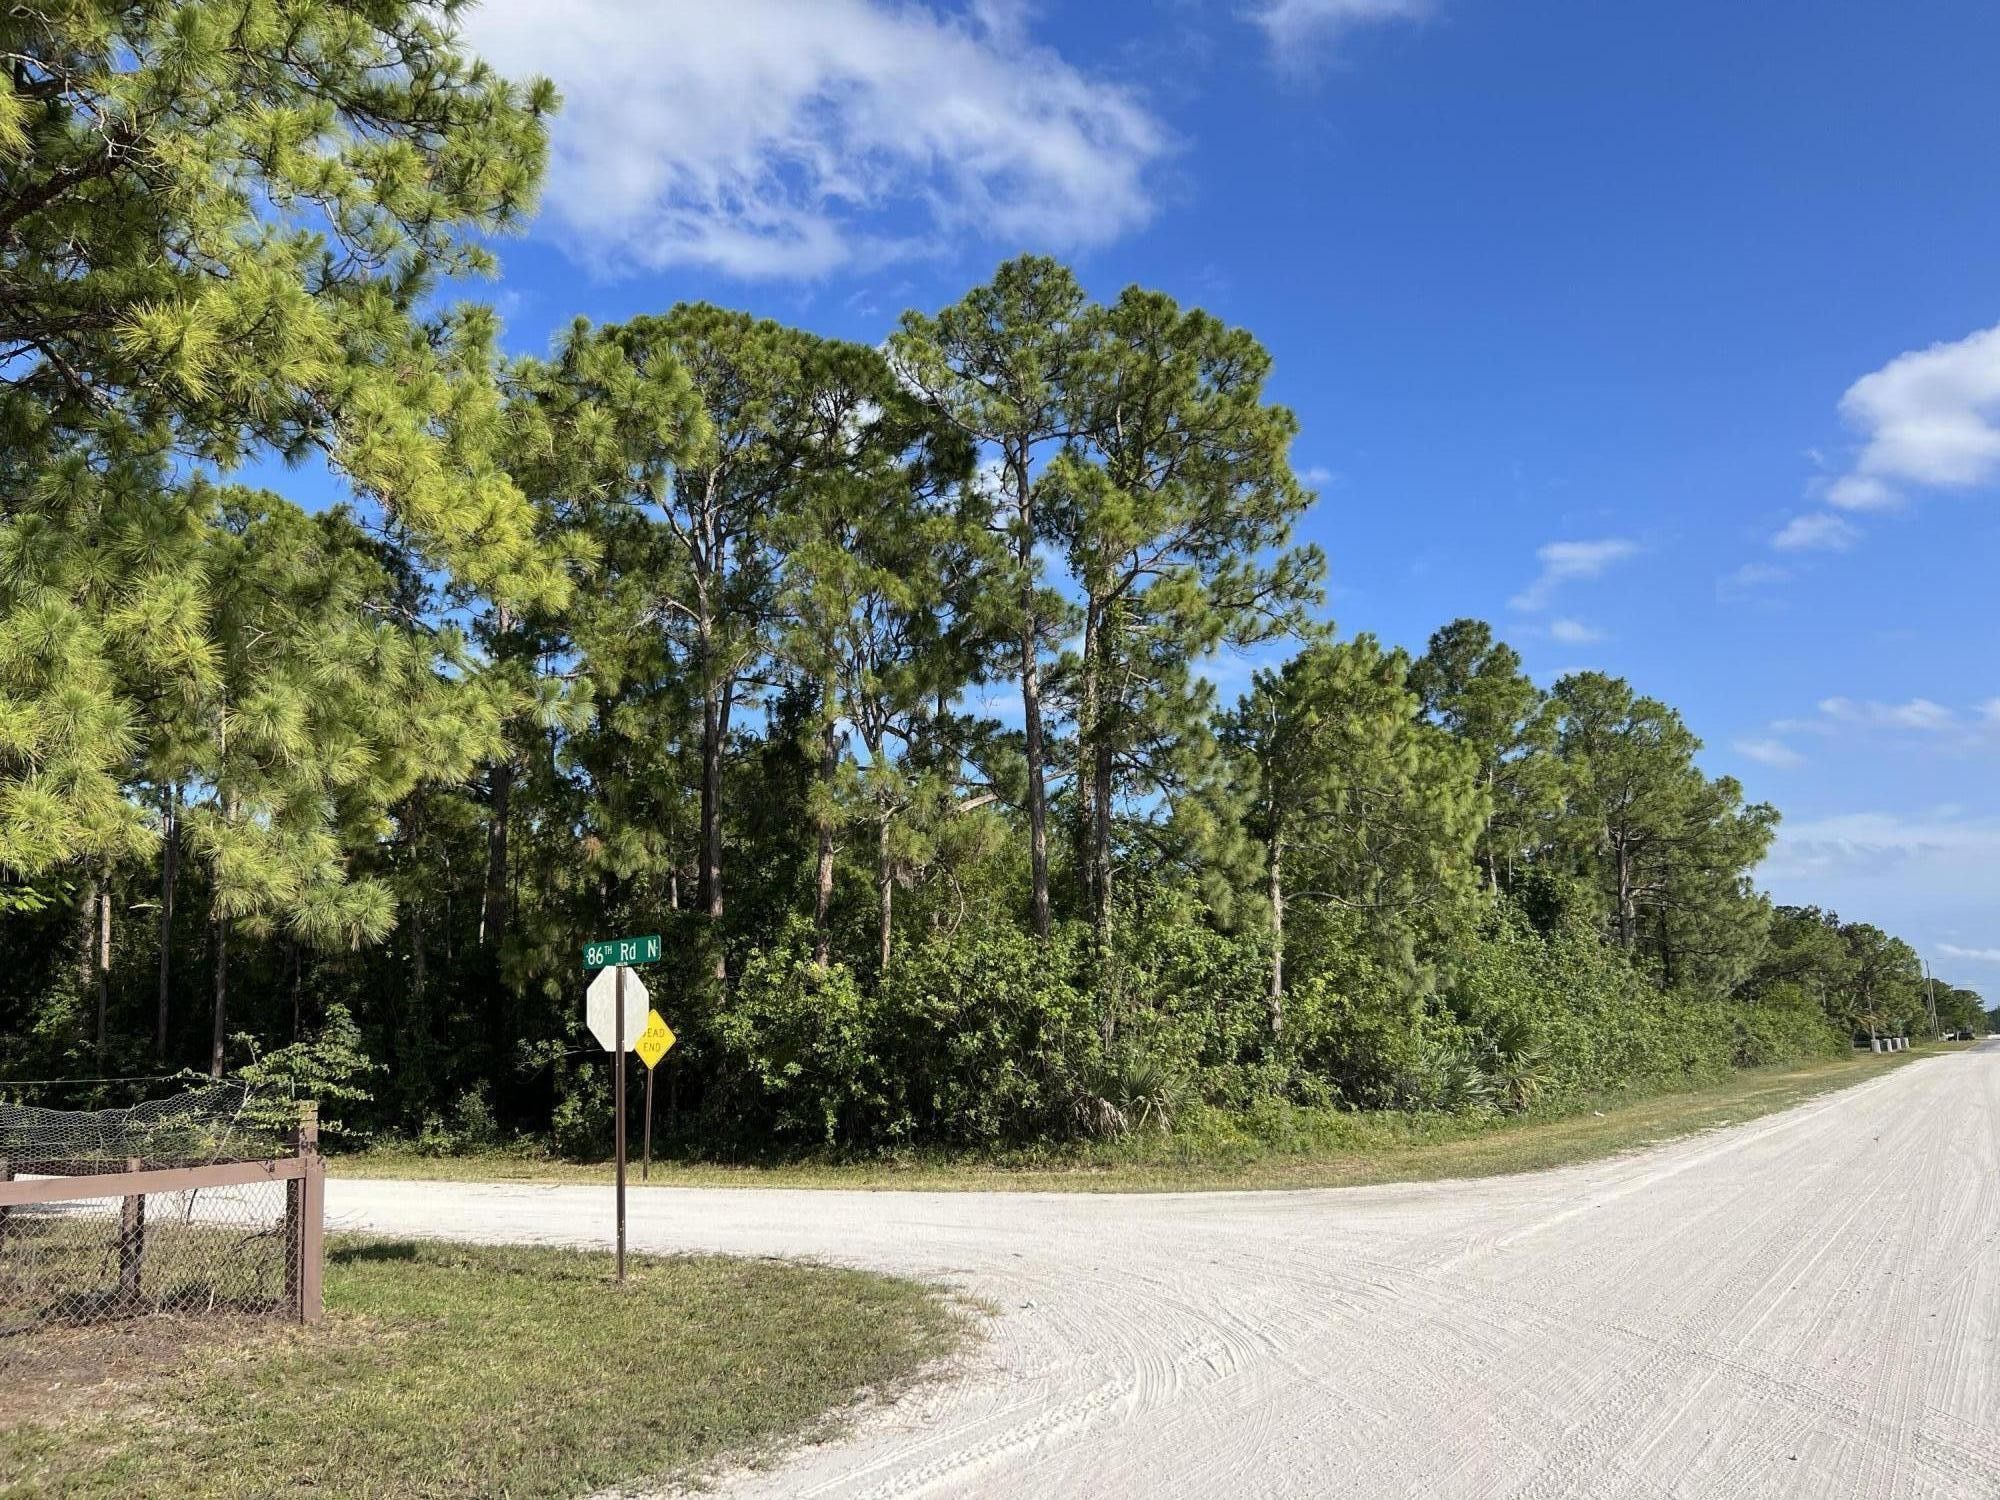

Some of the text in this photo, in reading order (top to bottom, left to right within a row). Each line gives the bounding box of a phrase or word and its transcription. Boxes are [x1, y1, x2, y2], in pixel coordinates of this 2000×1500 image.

[587, 939, 657, 965] 86TH Rd N
[643, 1042, 661, 1053] END
